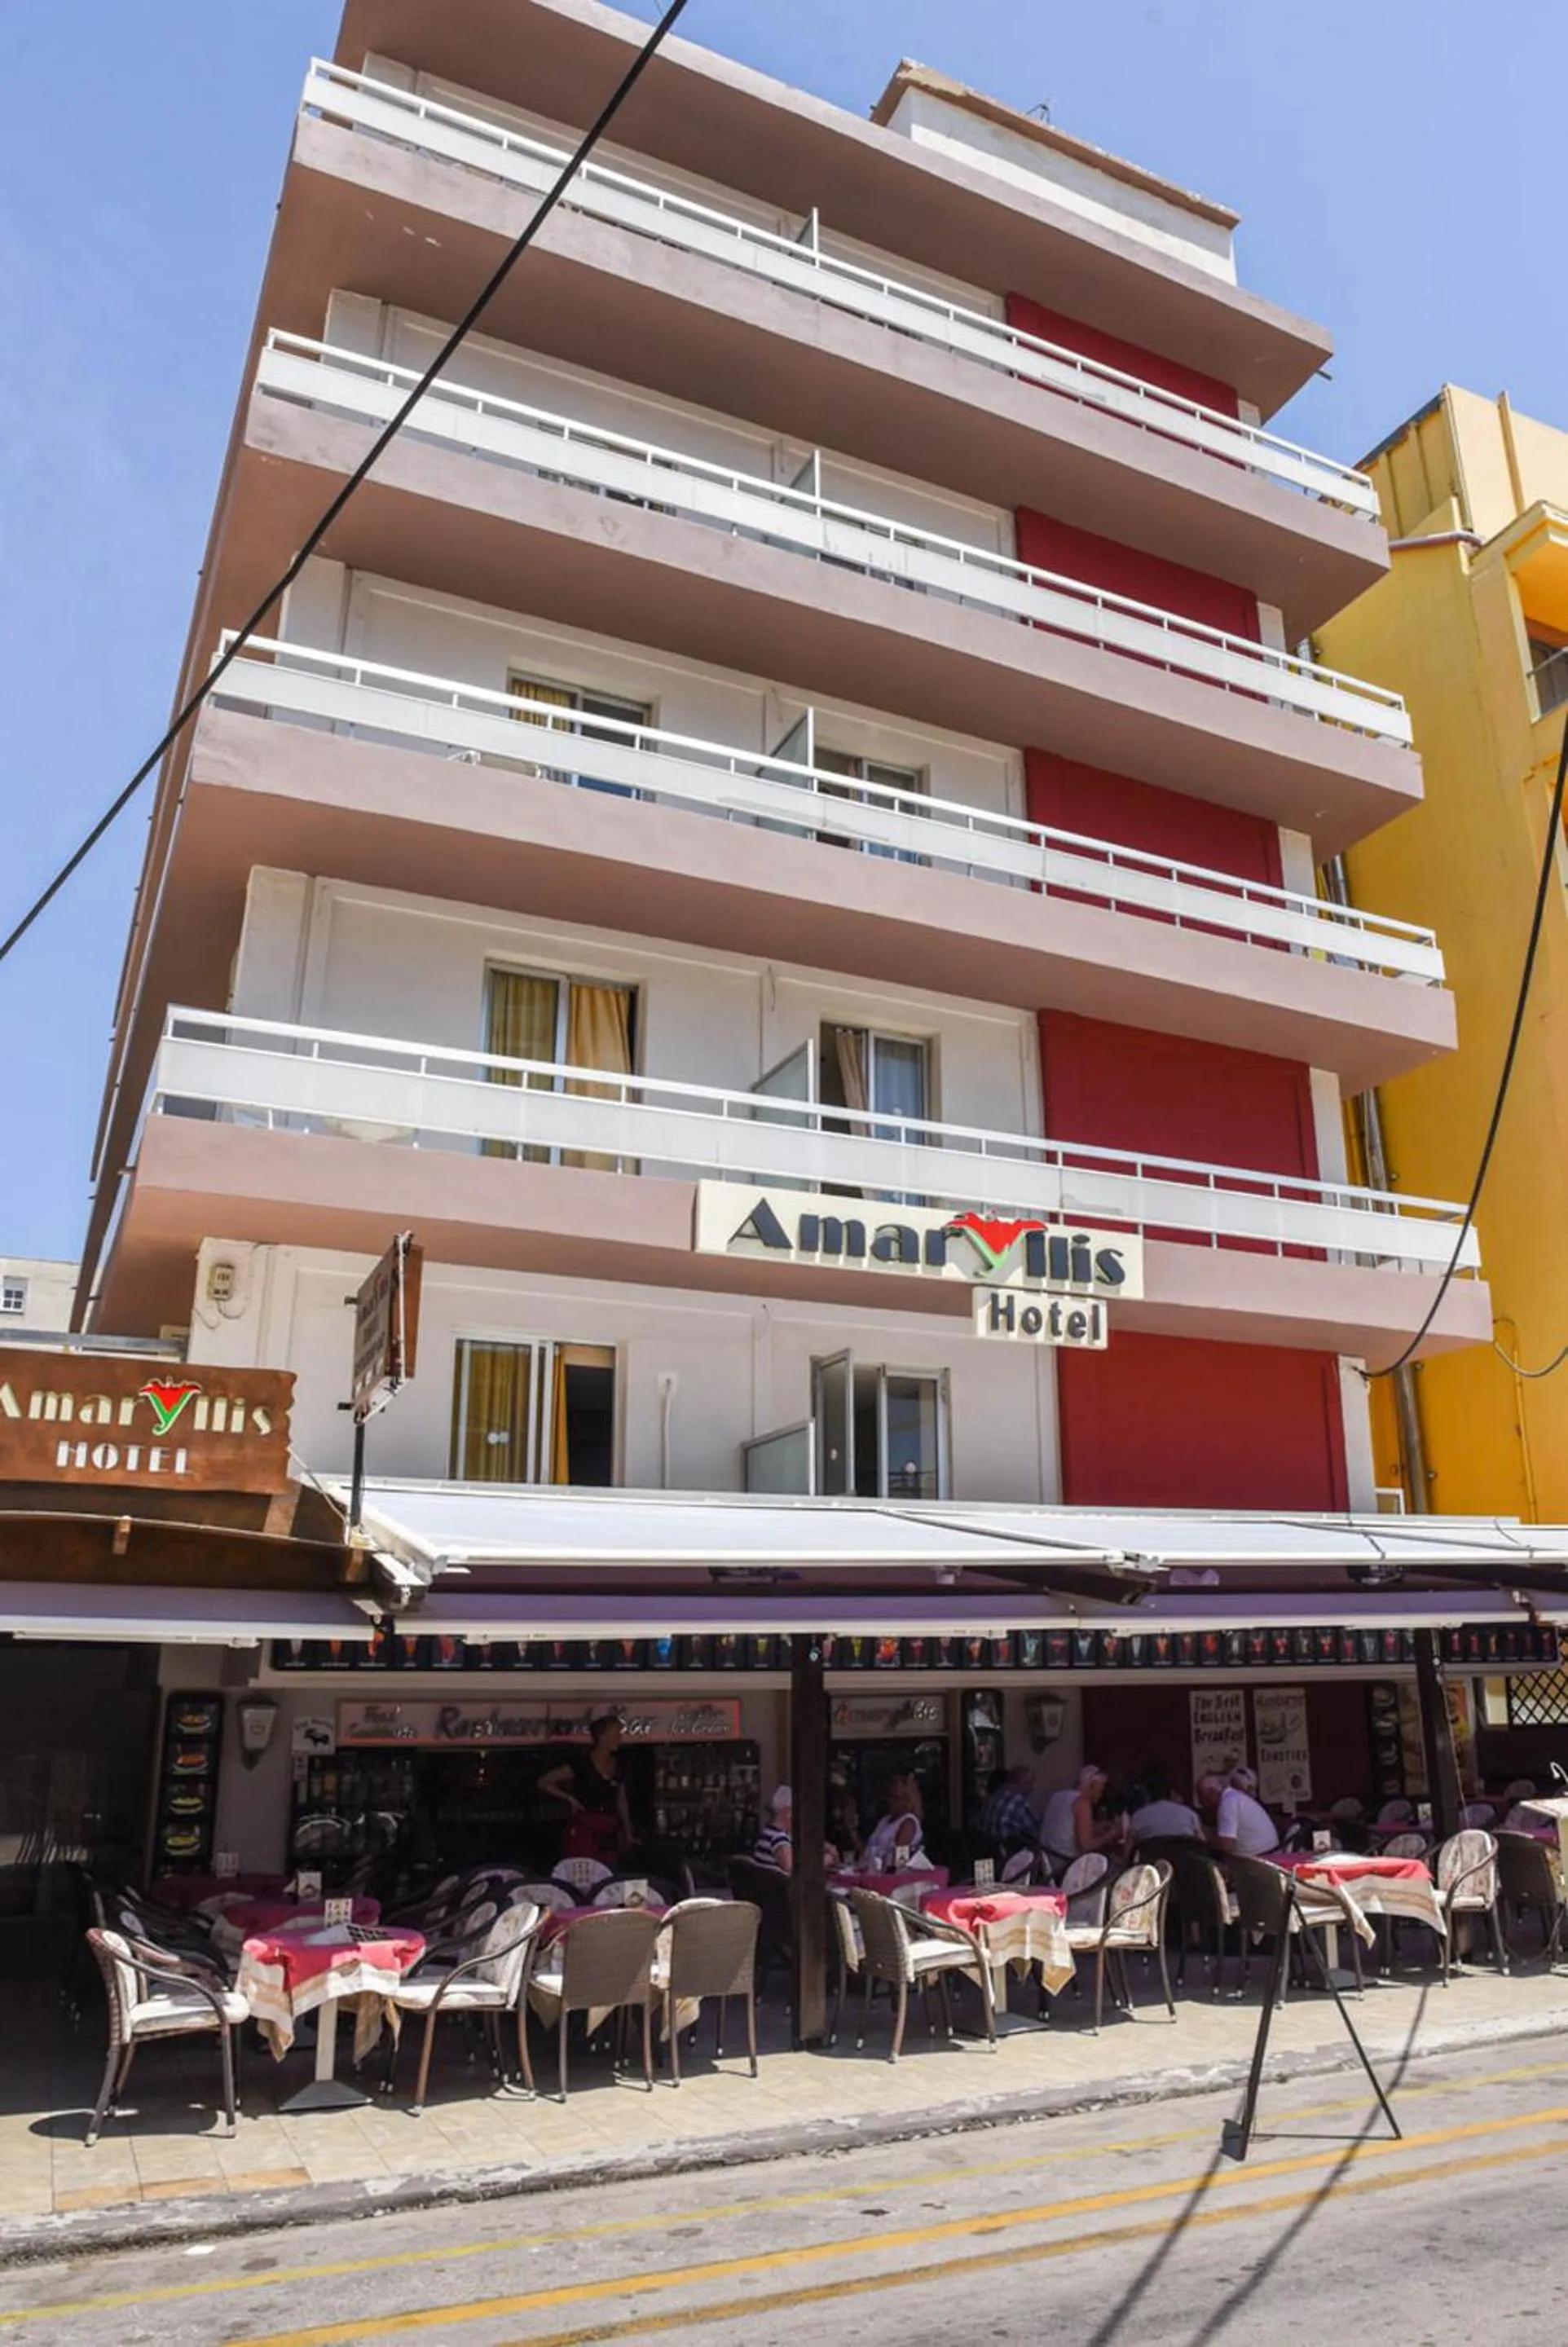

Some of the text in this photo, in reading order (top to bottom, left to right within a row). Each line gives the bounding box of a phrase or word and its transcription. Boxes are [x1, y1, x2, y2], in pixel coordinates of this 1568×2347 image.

[727, 1197, 1125, 1285] Amaryllis
[989, 1292, 1101, 1341] Hotel
[56, 1440, 195, 1476] HOTEL
